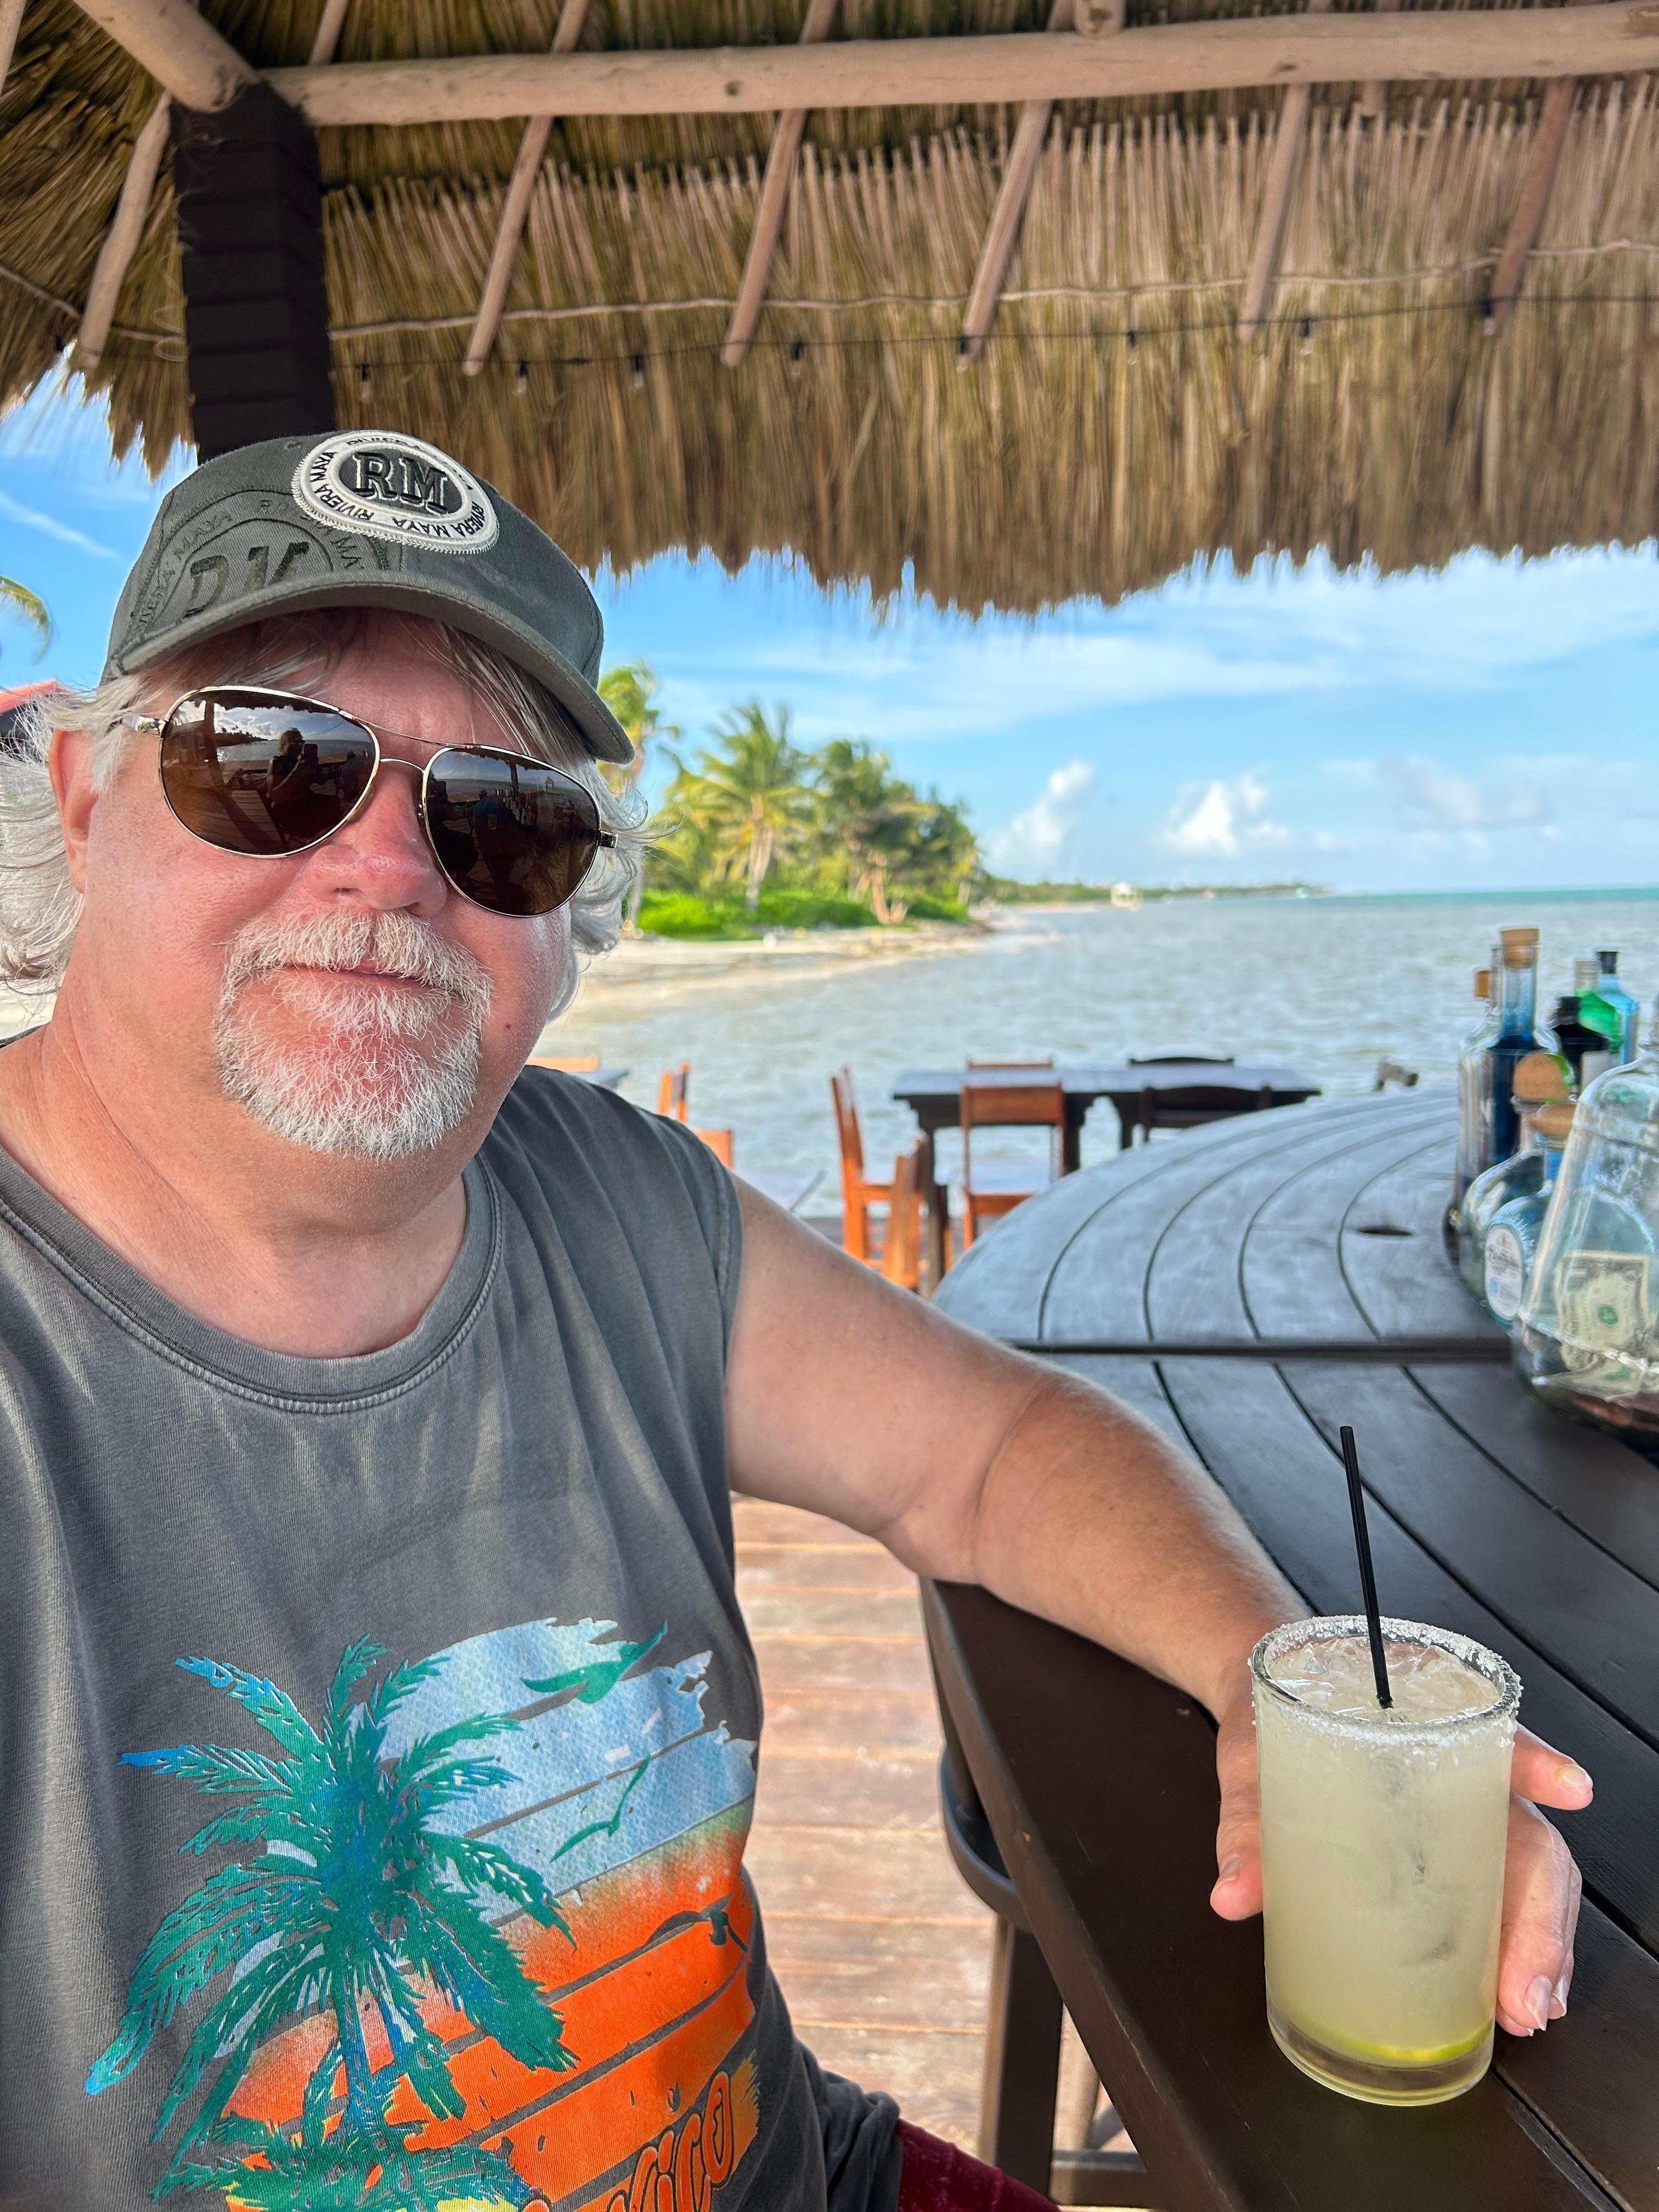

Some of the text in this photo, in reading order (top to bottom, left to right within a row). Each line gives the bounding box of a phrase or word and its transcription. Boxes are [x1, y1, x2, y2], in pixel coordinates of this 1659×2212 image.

[309, 452, 375, 520] RIVIERA MAYA
[352, 450, 449, 515] RM
[392, 517, 452, 538] MAYA
